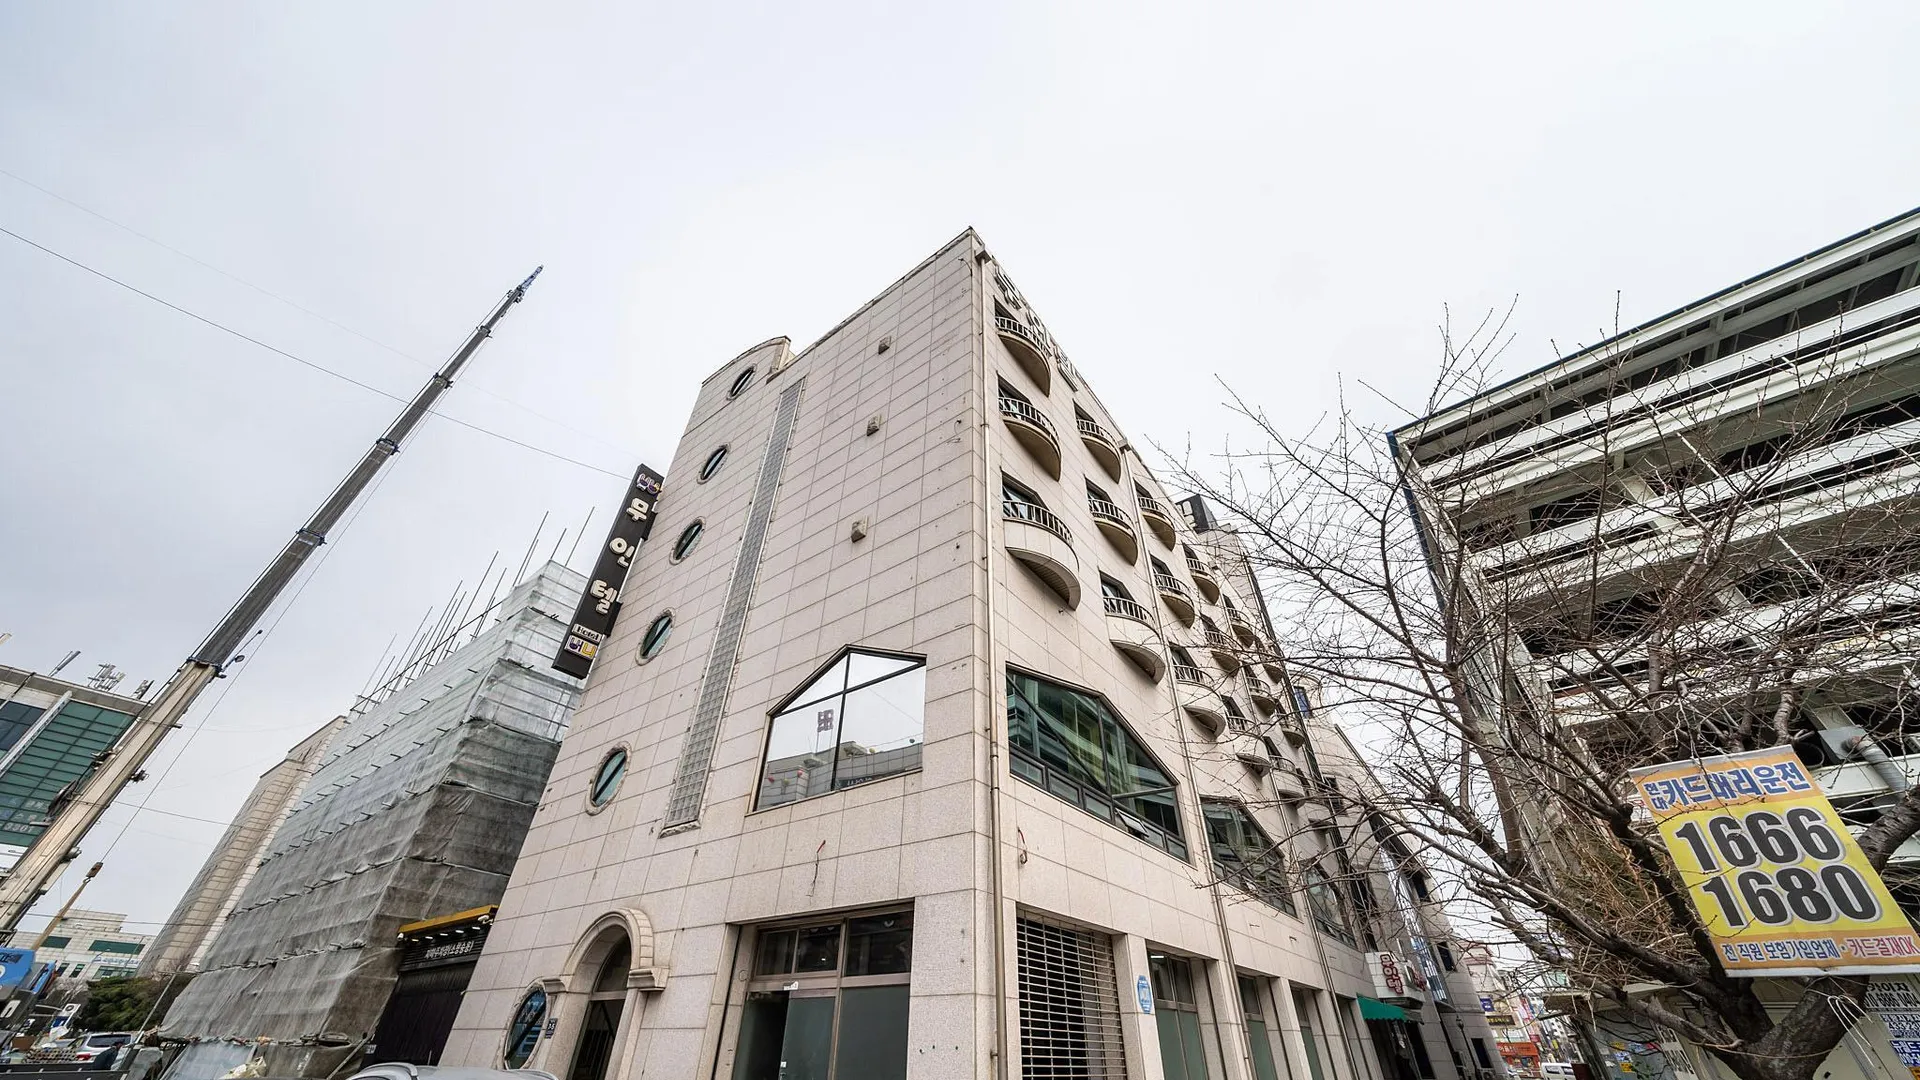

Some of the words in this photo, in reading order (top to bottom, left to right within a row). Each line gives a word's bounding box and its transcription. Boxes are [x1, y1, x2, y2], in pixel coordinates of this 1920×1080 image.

[590, 497, 650, 615] 무인텔
[1662, 762, 1811, 806] 카드대리운전
[1675, 807, 1842, 872] 1666
[1702, 864, 1879, 927] 1680
[1380, 953, 1404, 994] 무인텔
[1722, 943, 1738, 961] 전
[1737, 943, 1764, 961] 직원
[1763, 940, 1840, 960] 보험가입업체
